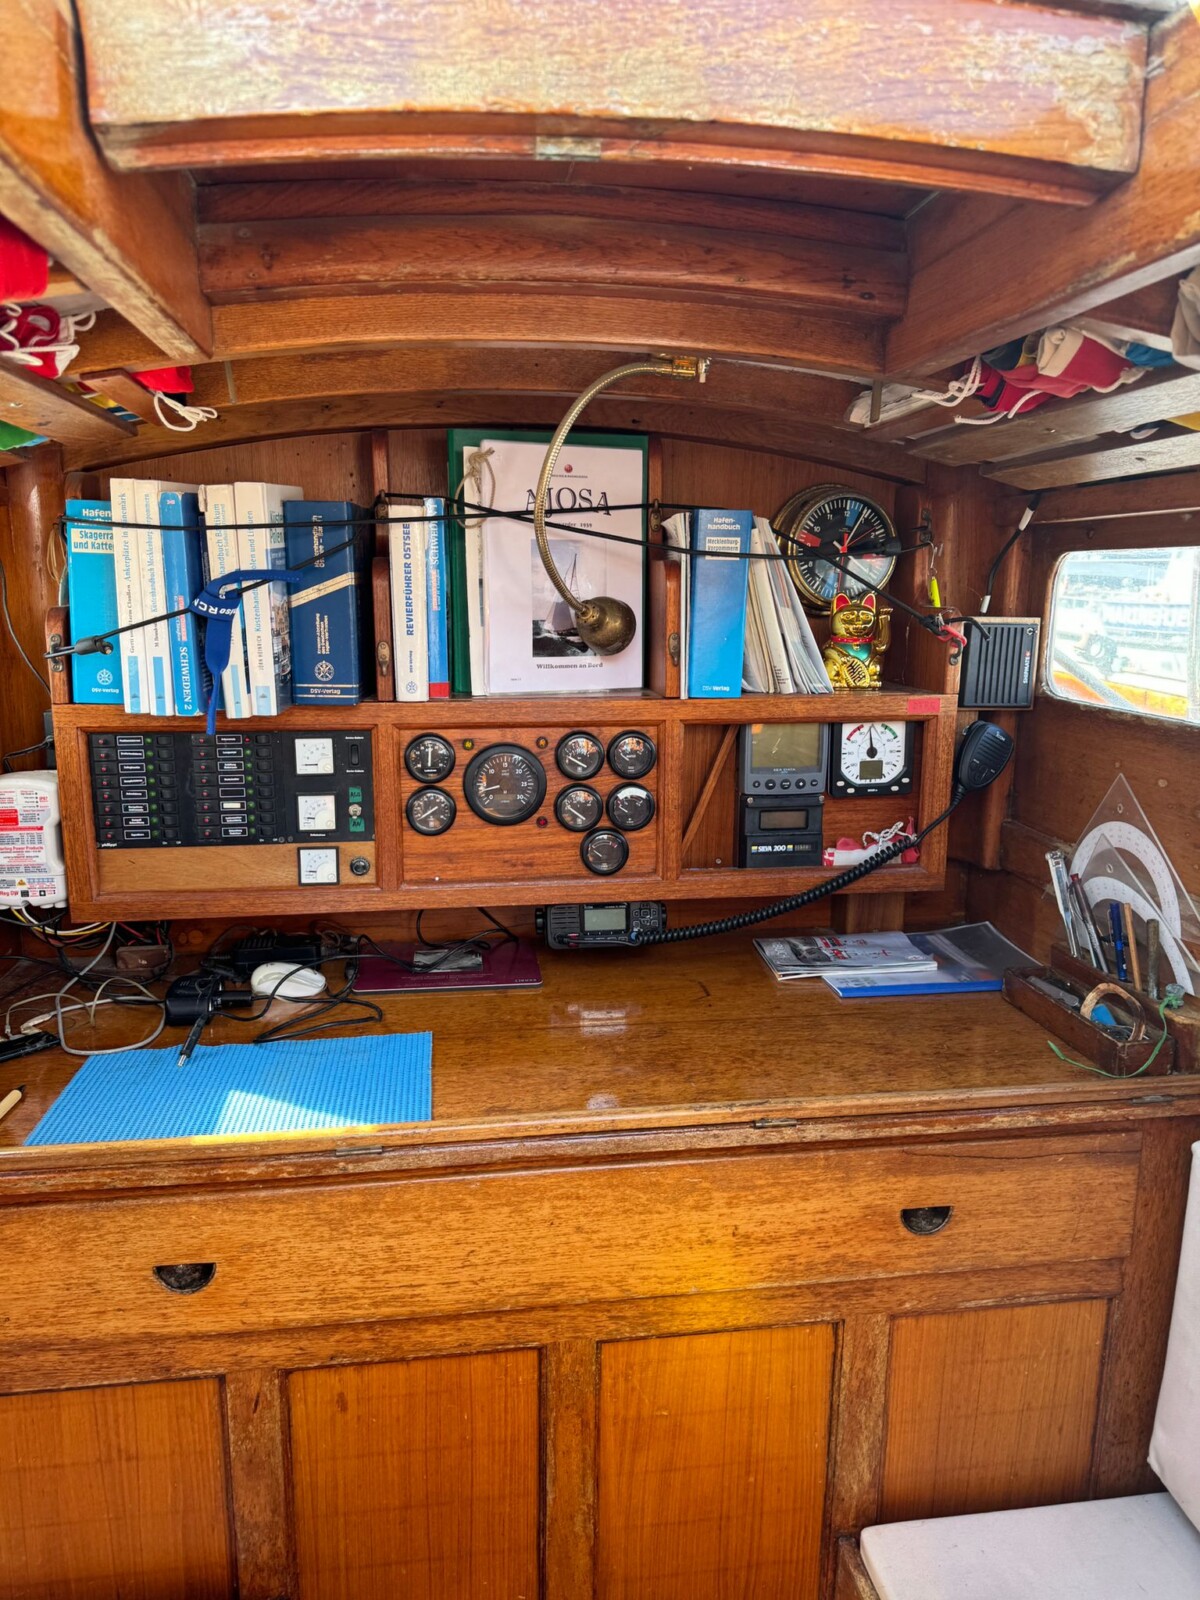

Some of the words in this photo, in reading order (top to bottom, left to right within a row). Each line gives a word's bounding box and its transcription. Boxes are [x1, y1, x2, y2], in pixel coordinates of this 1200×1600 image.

[119, 493, 128, 526] änemark
[213, 504, 222, 537] Batikum
[73, 542, 89, 550] und
[79, 530, 113, 541] Skagerra
[402, 524, 411, 559] OSTSEE
[403, 562, 414, 636] REVIERFÜHRER
[180, 646, 192, 703] SCHWEDEN
[773, 844, 787, 852] 200
